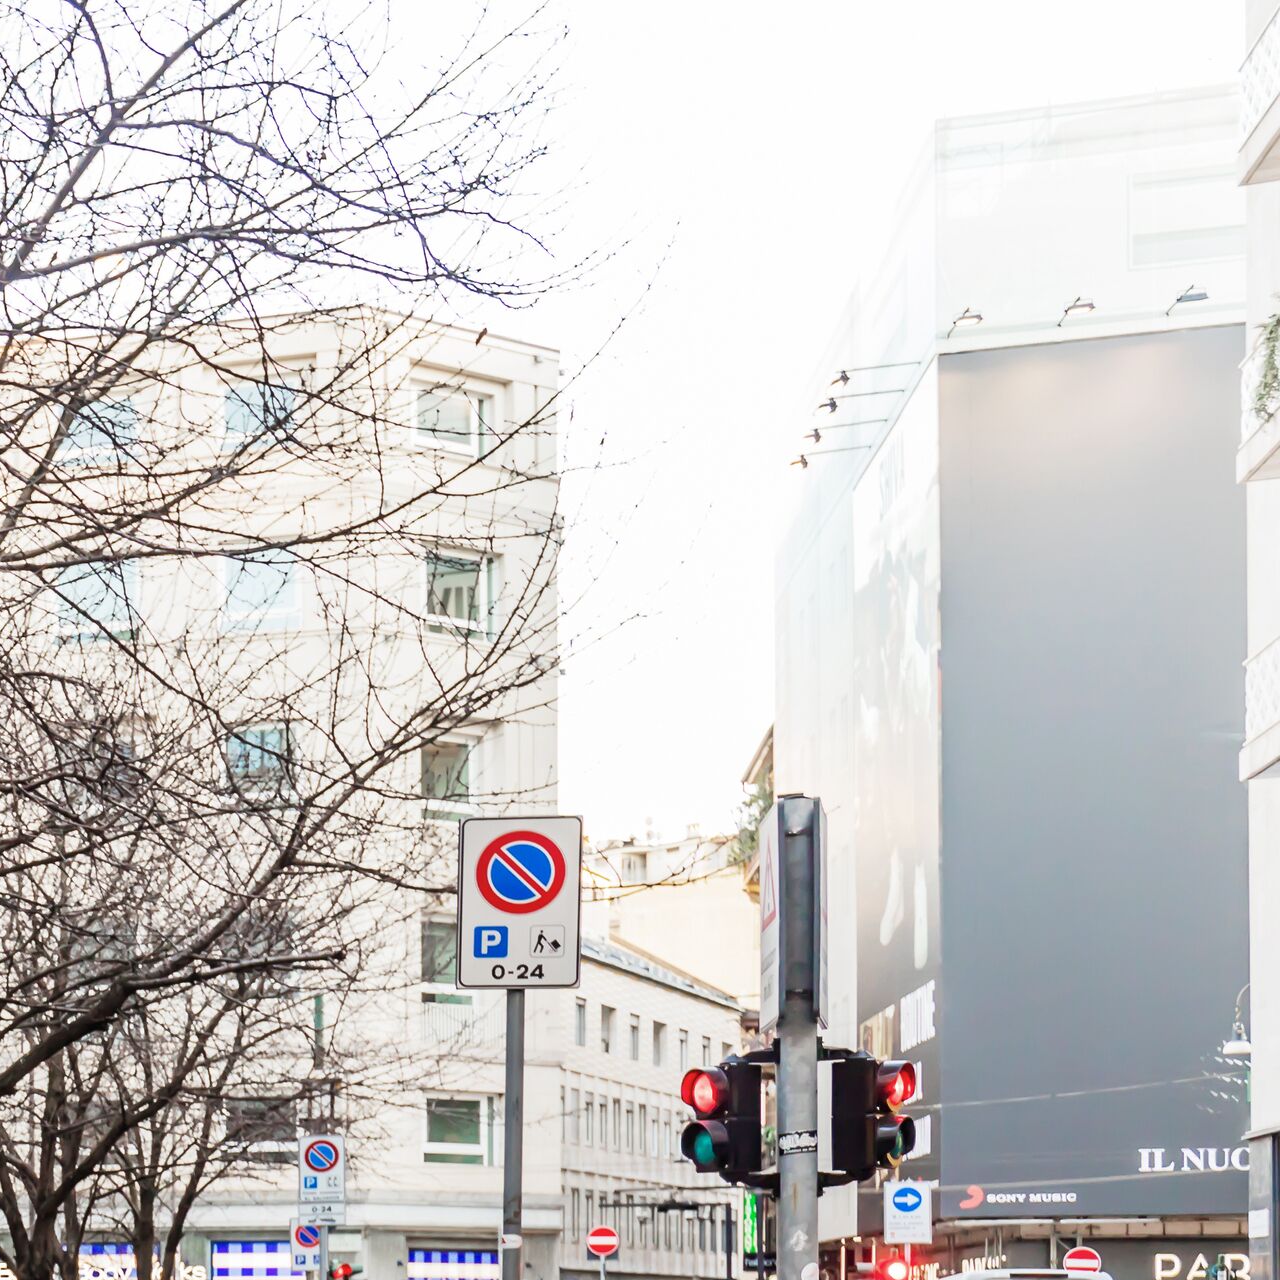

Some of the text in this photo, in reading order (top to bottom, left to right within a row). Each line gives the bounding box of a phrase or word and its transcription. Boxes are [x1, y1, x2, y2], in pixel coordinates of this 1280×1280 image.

[491, 964, 545, 980] 0-24
[1139, 1147, 1174, 1173] IL
[986, 1192, 1077, 1203] SONY MUSIC
